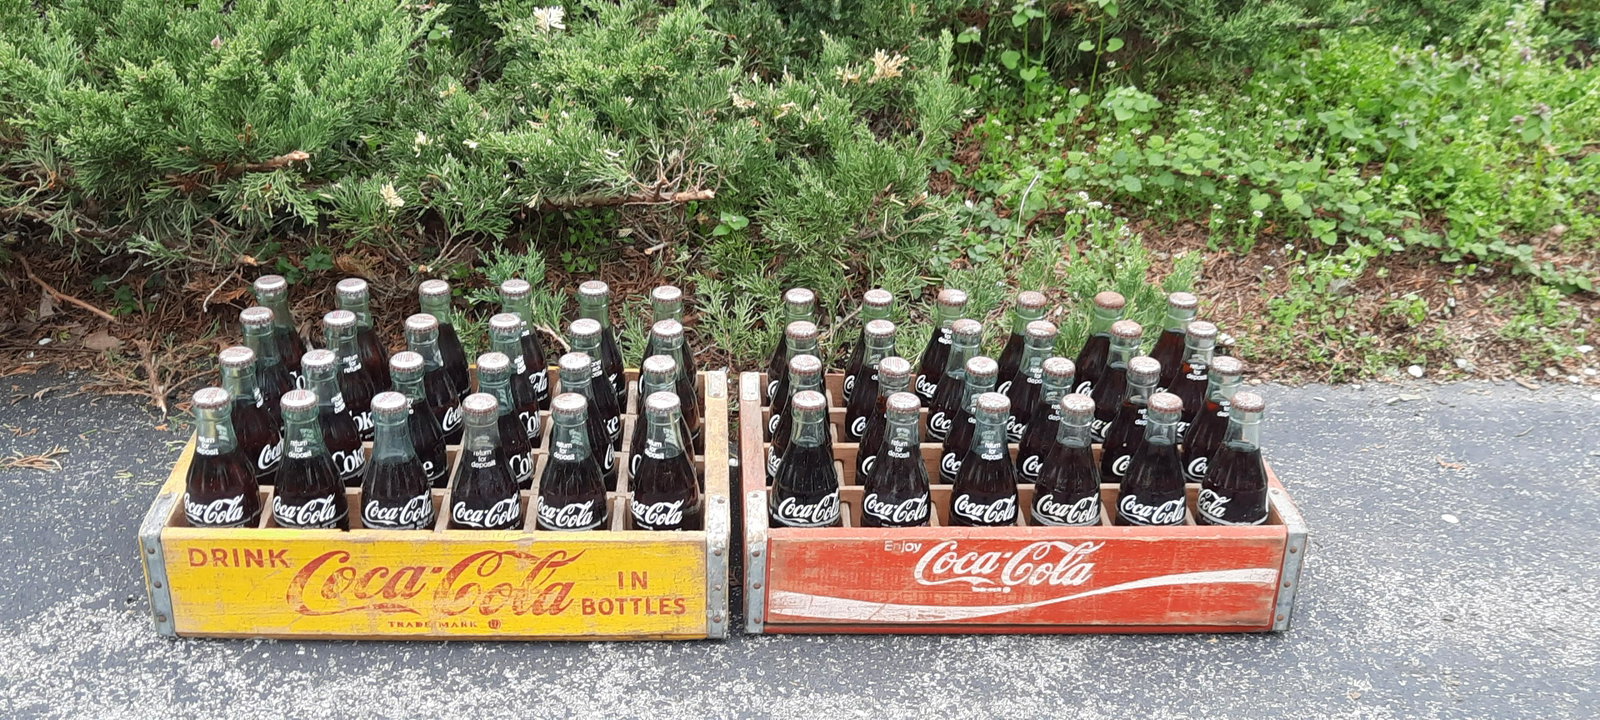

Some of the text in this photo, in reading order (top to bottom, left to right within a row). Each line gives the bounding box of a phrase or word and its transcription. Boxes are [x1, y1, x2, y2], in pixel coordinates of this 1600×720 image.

[272, 493, 336, 525] Coca-Cola
[364, 490, 431, 526] Coca-Cola
[452, 490, 520, 528] Coca-Cola
[863, 491, 928, 523] Coca-Cola
[954, 493, 1016, 523] Coca-Cola
[1036, 493, 1098, 524] Coca-Cola
[1120, 494, 1185, 524] Coca-Cola
[187, 547, 291, 569] DRINK
[884, 540, 1106, 586] Enjoy Coca-Cola
[286, 549, 586, 616] Coca-Cola
[617, 570, 648, 590] IN
[581, 597, 686, 616] BOTTLES
[439, 621, 477, 629] MARK
